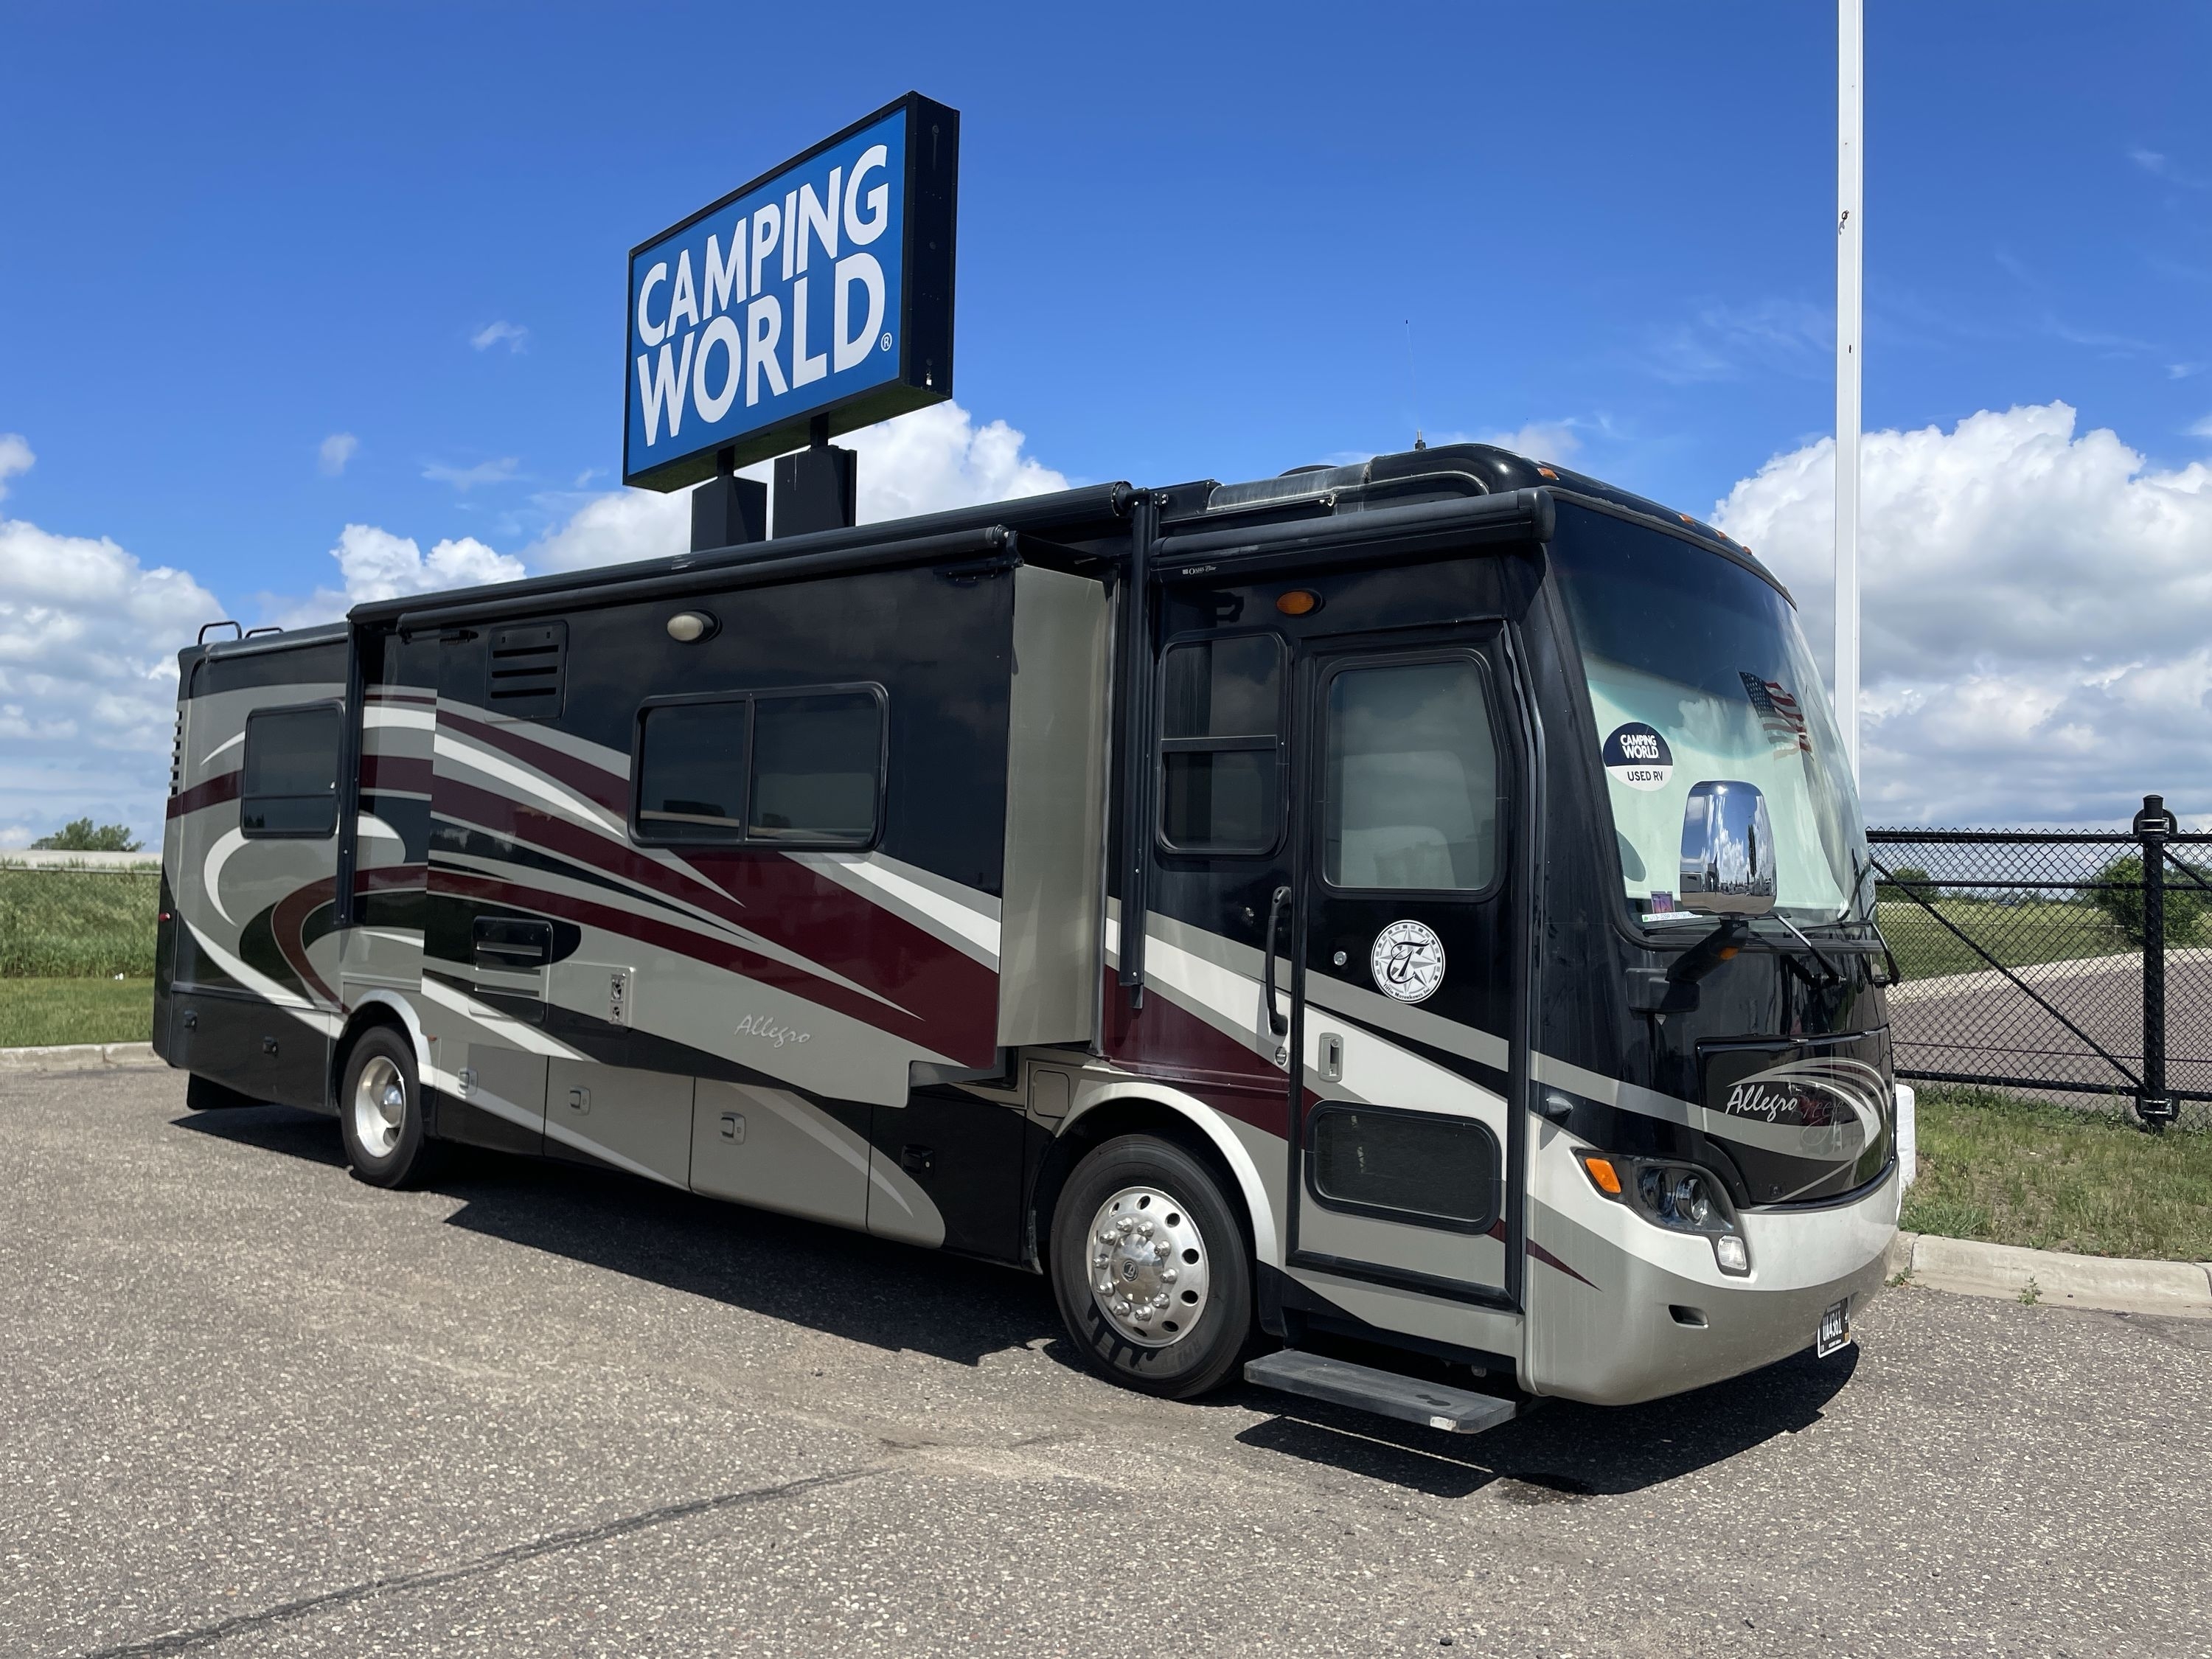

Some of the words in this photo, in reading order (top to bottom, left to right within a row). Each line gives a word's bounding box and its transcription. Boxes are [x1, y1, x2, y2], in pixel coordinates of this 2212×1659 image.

[638, 145, 889, 347] CAMPING
[637, 252, 886, 447] WORLD
[1620, 734, 1657, 745] CAMPING
[1622, 745, 1659, 759] WORLD
[1627, 771, 1652, 782] USED
[1653, 771, 1663, 781] RV
[734, 1014, 811, 1048] Allegro
[1725, 1085, 1798, 1122] Allegro
